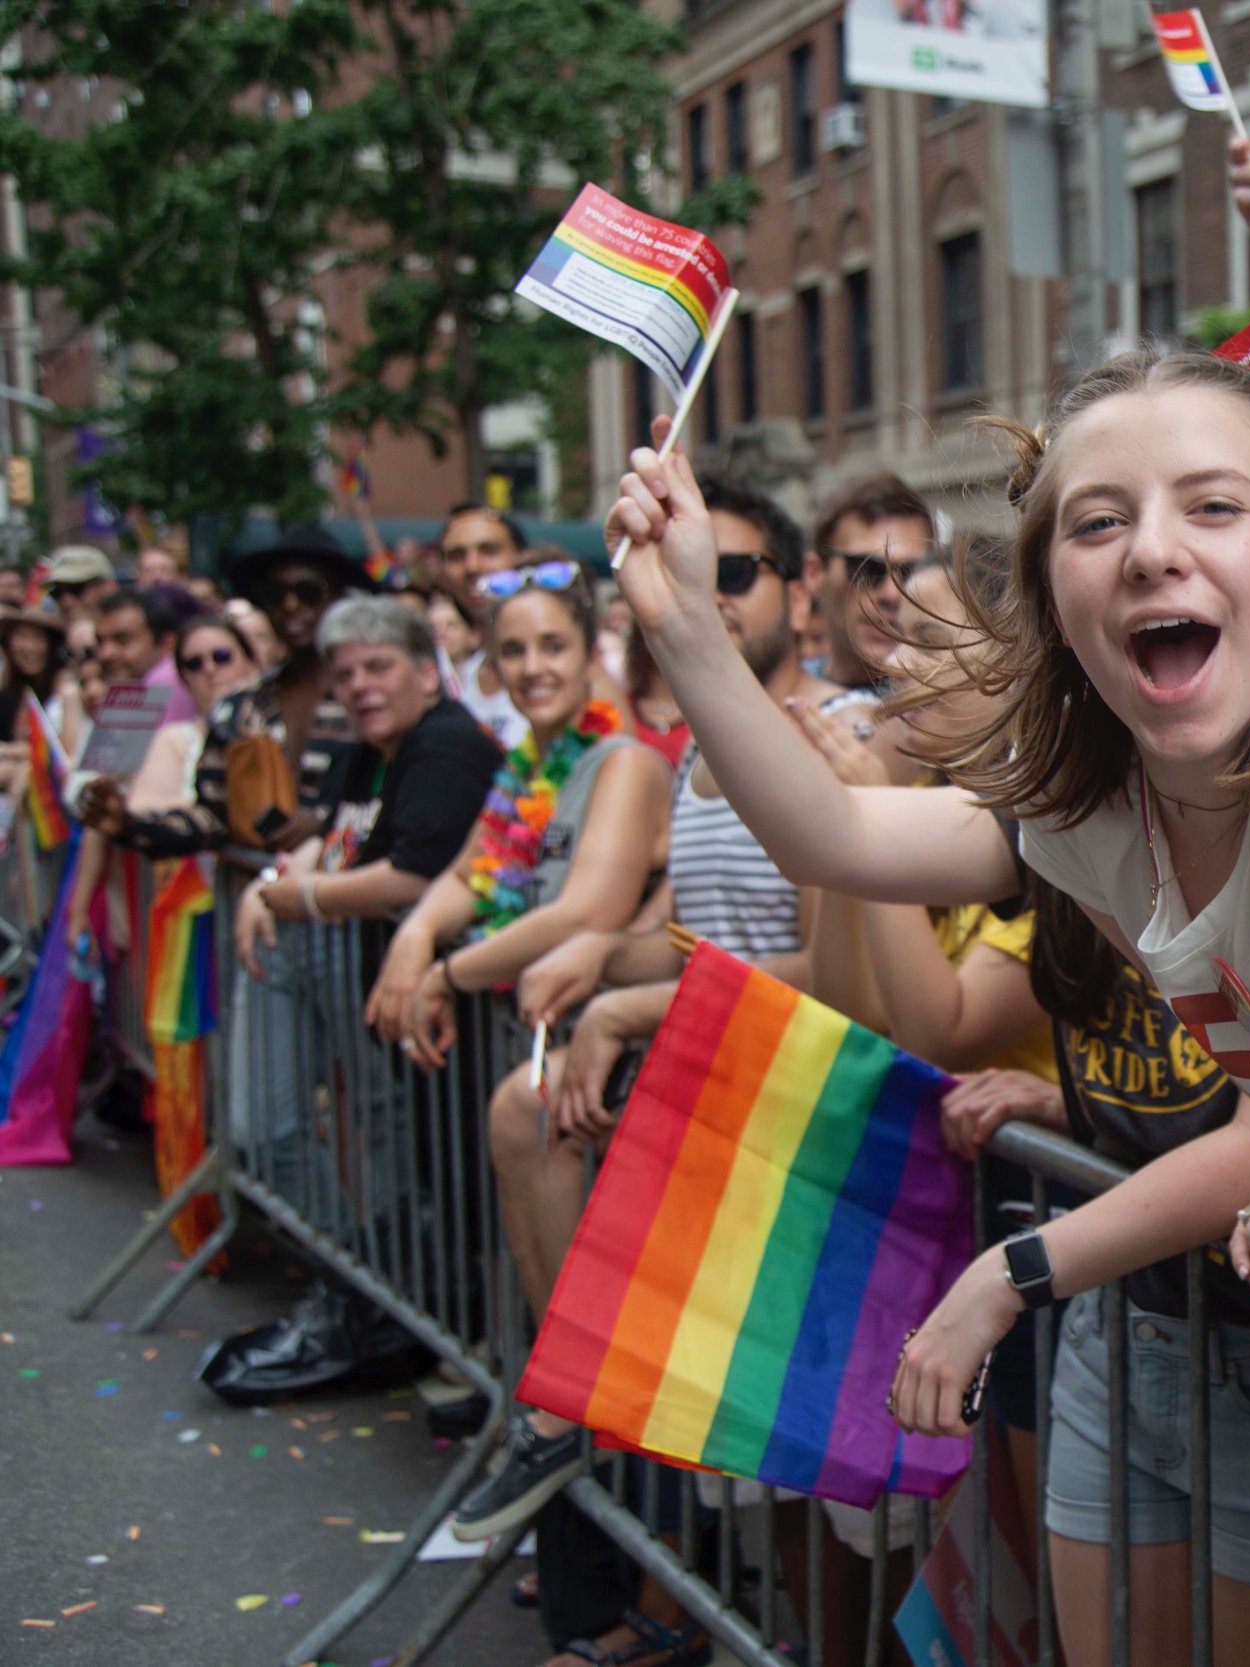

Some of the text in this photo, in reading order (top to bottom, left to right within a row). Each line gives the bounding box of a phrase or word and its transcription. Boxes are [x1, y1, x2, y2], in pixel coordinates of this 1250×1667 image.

[577, 215, 595, 230] for
[595, 226, 633, 252] waving
[634, 243, 655, 260] this
[584, 206, 605, 223] you
[606, 218, 639, 240] could
[638, 231, 654, 247] be
[653, 239, 700, 265] arrested
[697, 261, 710, 274] or
[604, 203, 633, 224] more
[634, 217, 658, 235] than
[659, 227, 674, 239] 75
